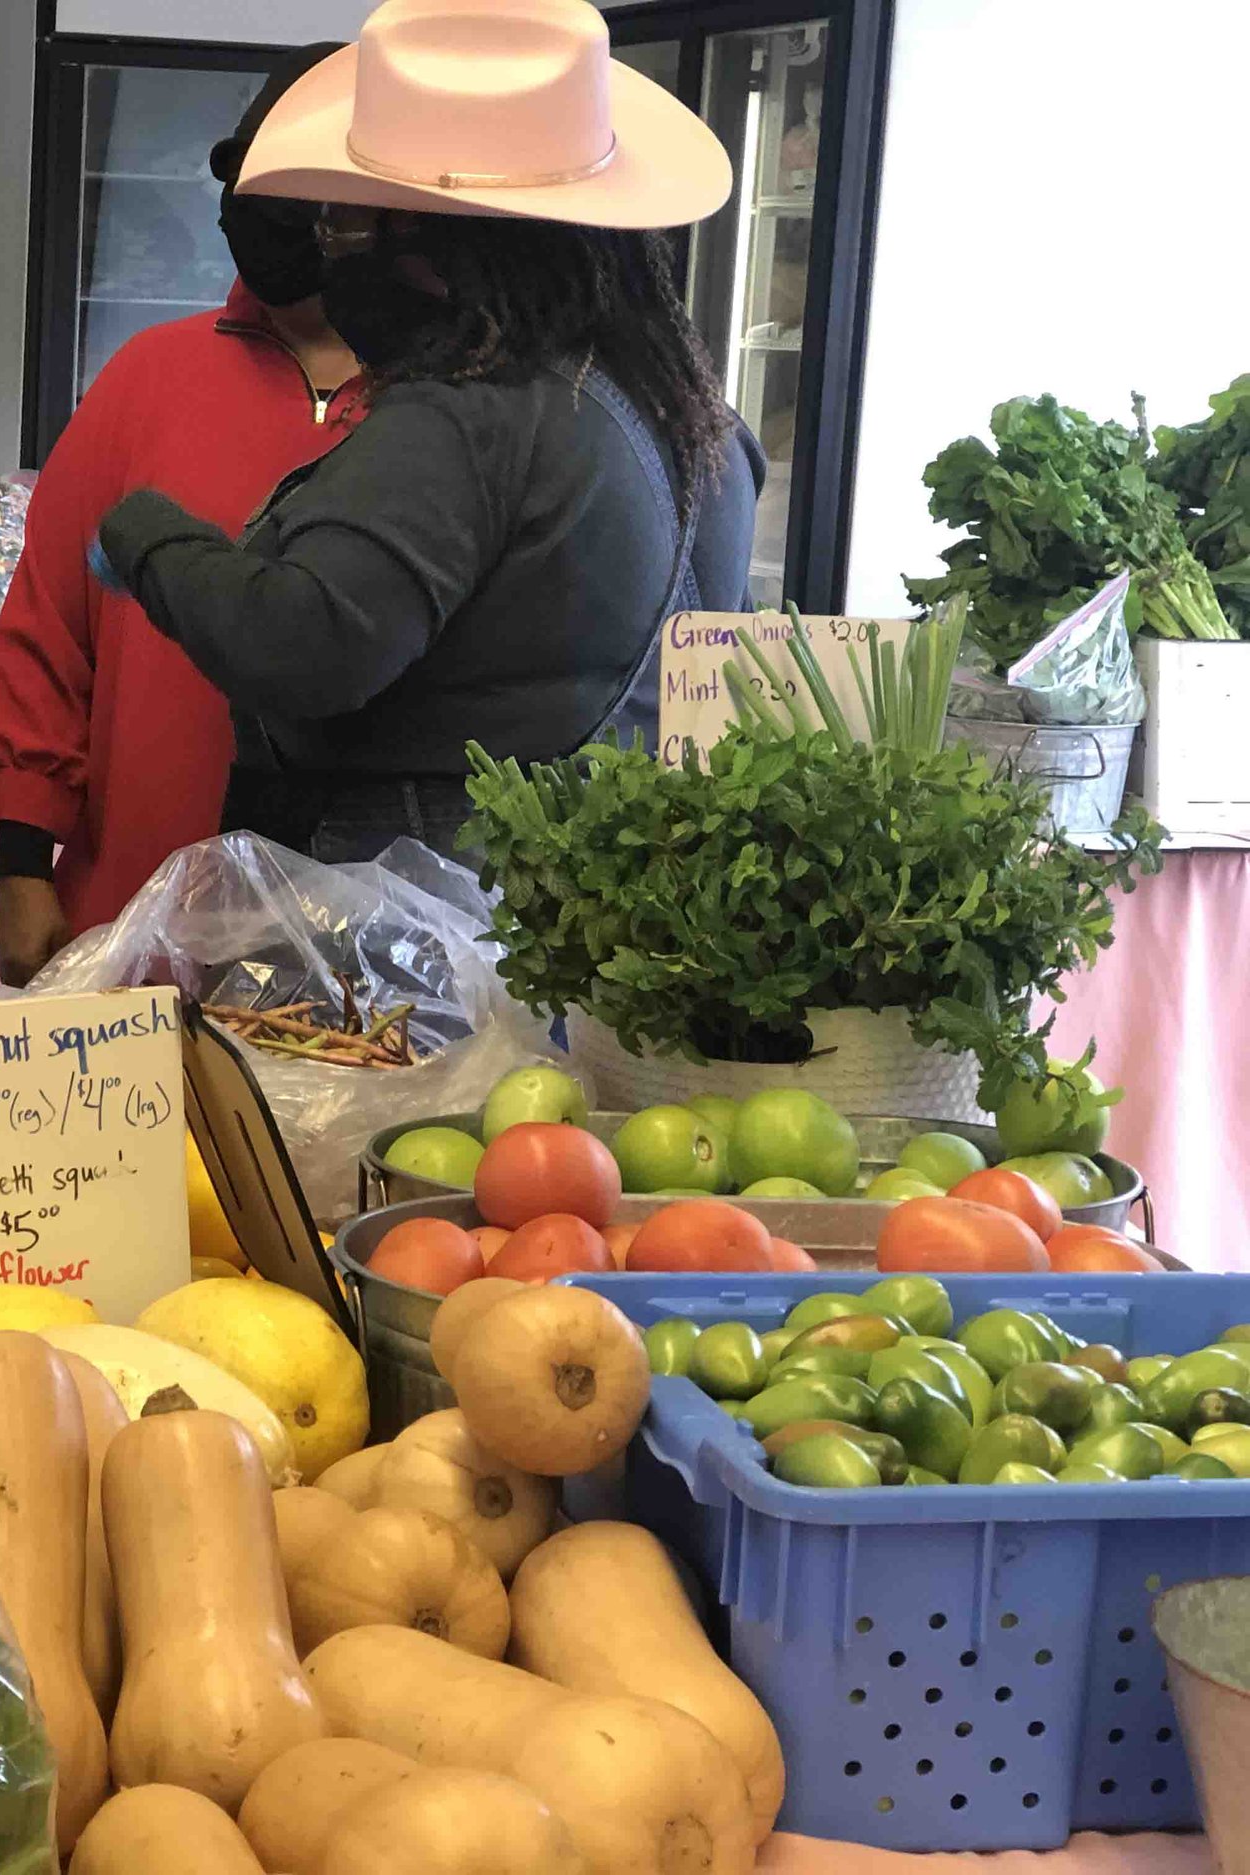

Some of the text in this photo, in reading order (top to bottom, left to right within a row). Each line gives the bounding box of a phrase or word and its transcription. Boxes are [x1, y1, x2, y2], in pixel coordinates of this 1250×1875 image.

[670, 612, 740, 650] Green
[752, 616, 813, 643] Onios
[667, 668, 720, 702] Mint
[48, 997, 177, 1076] squash
[52, 1149, 139, 1201] squa
